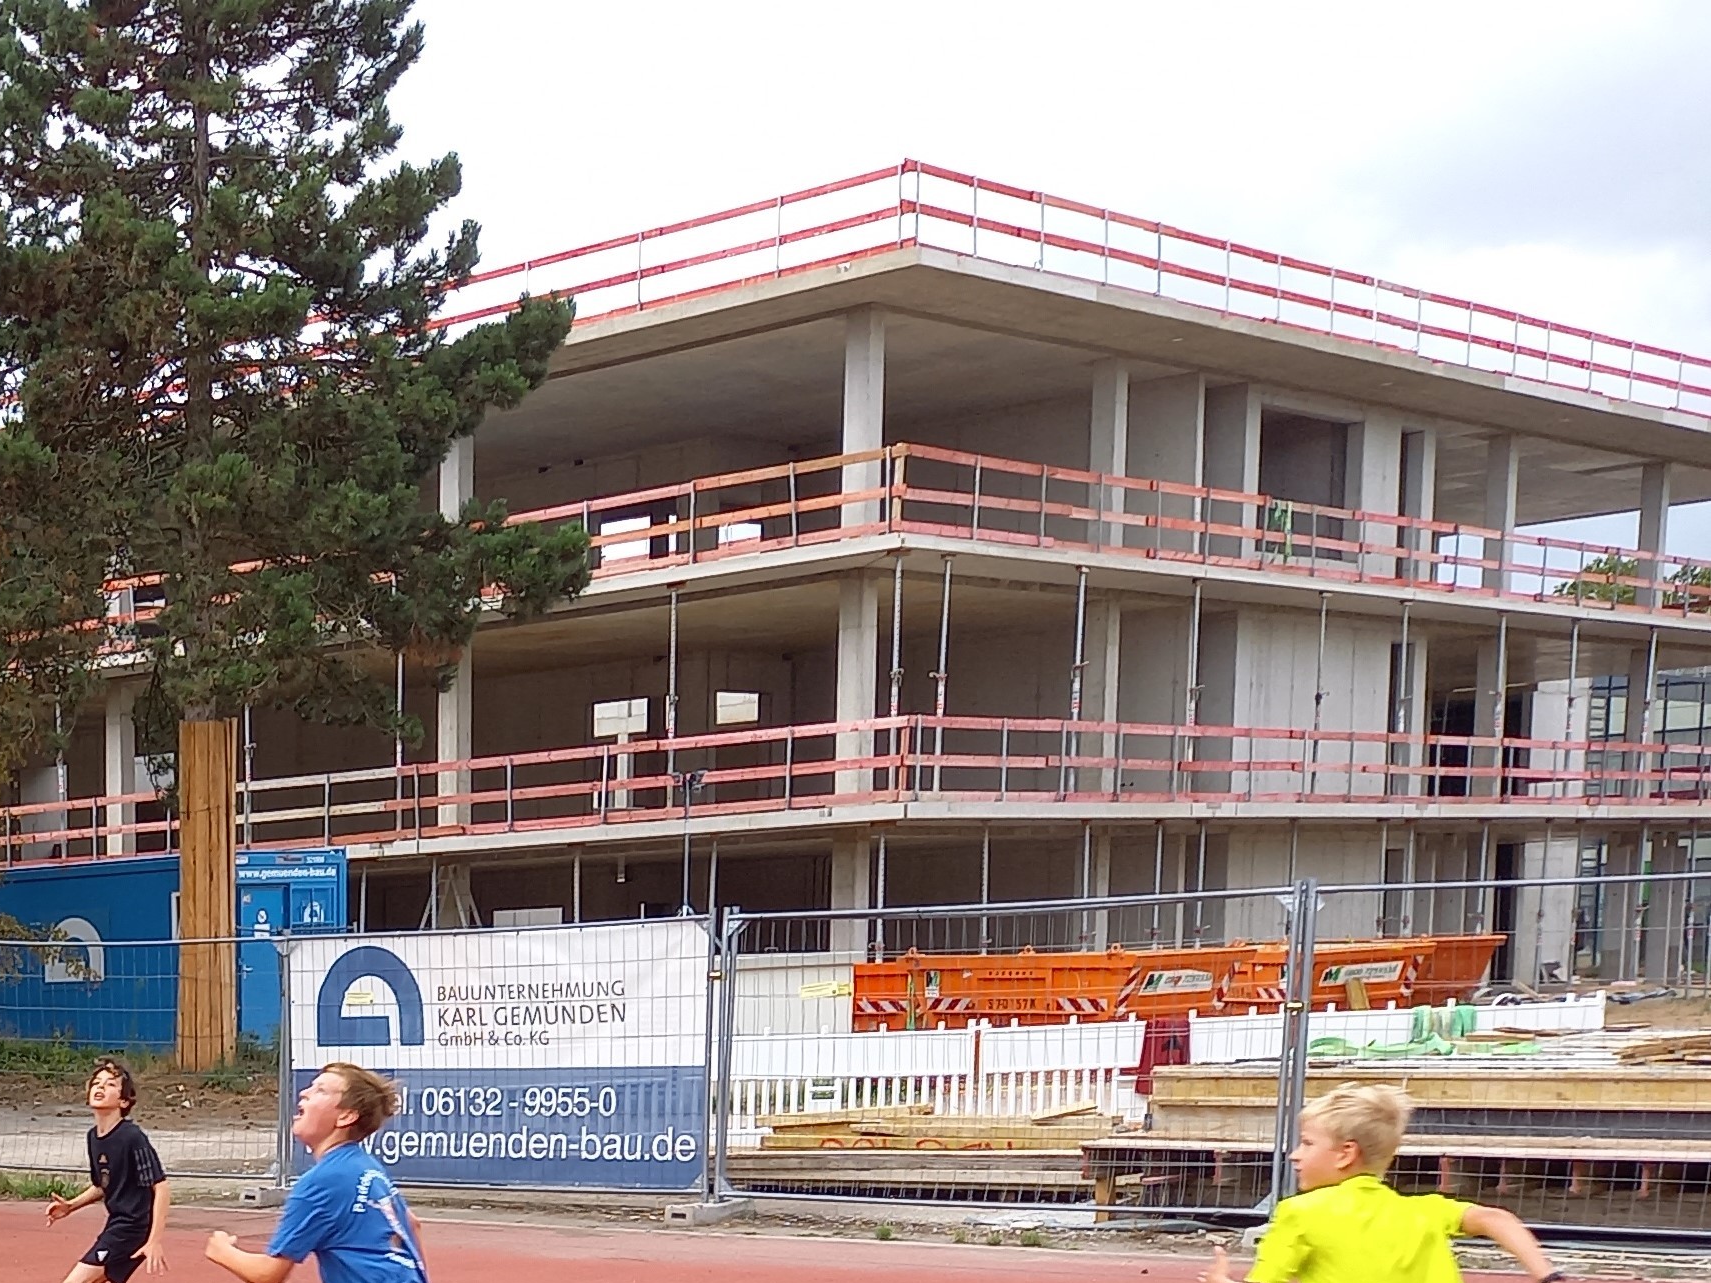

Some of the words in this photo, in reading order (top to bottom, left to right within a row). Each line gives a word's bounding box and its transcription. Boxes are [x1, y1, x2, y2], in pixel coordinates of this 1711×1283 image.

[437, 980, 625, 1001] BAUUNTERNEHMUNG
[438, 1006, 488, 1027] KARL
[494, 1001, 627, 1026] GEMÜNDEN
[437, 1031, 484, 1046] GmbH
[488, 1031, 500, 1046] &
[504, 1031, 526, 1046] Co.
[529, 1030, 550, 1046] KG
[421, 1087, 502, 1116] 06132
[524, 1086, 617, 1117] 9955-0
